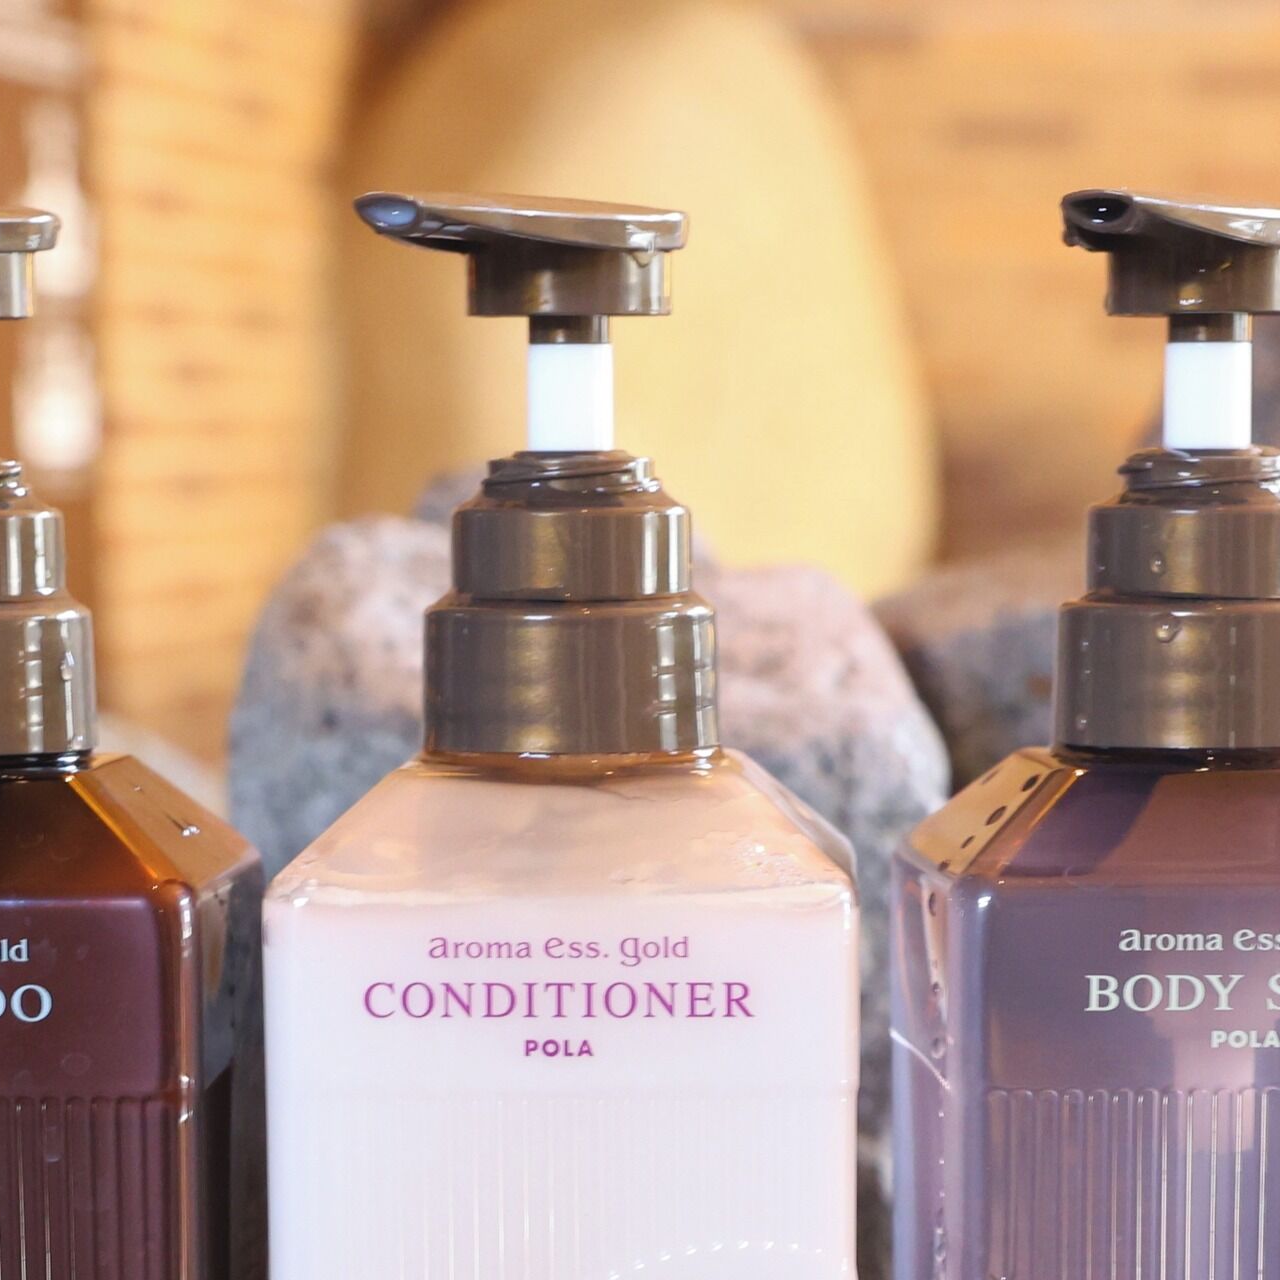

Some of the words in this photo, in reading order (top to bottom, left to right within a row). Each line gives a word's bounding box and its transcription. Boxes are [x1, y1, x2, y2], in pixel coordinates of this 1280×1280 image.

[428, 936, 532, 960] aroma
[544, 936, 609, 960] ess.
[620, 935, 690, 967] gold
[1119, 928, 1224, 951] aroma
[362, 981, 756, 1019] CONDITIONER
[1084, 974, 1245, 1012] BODY
[524, 1039, 594, 1058] POLA
